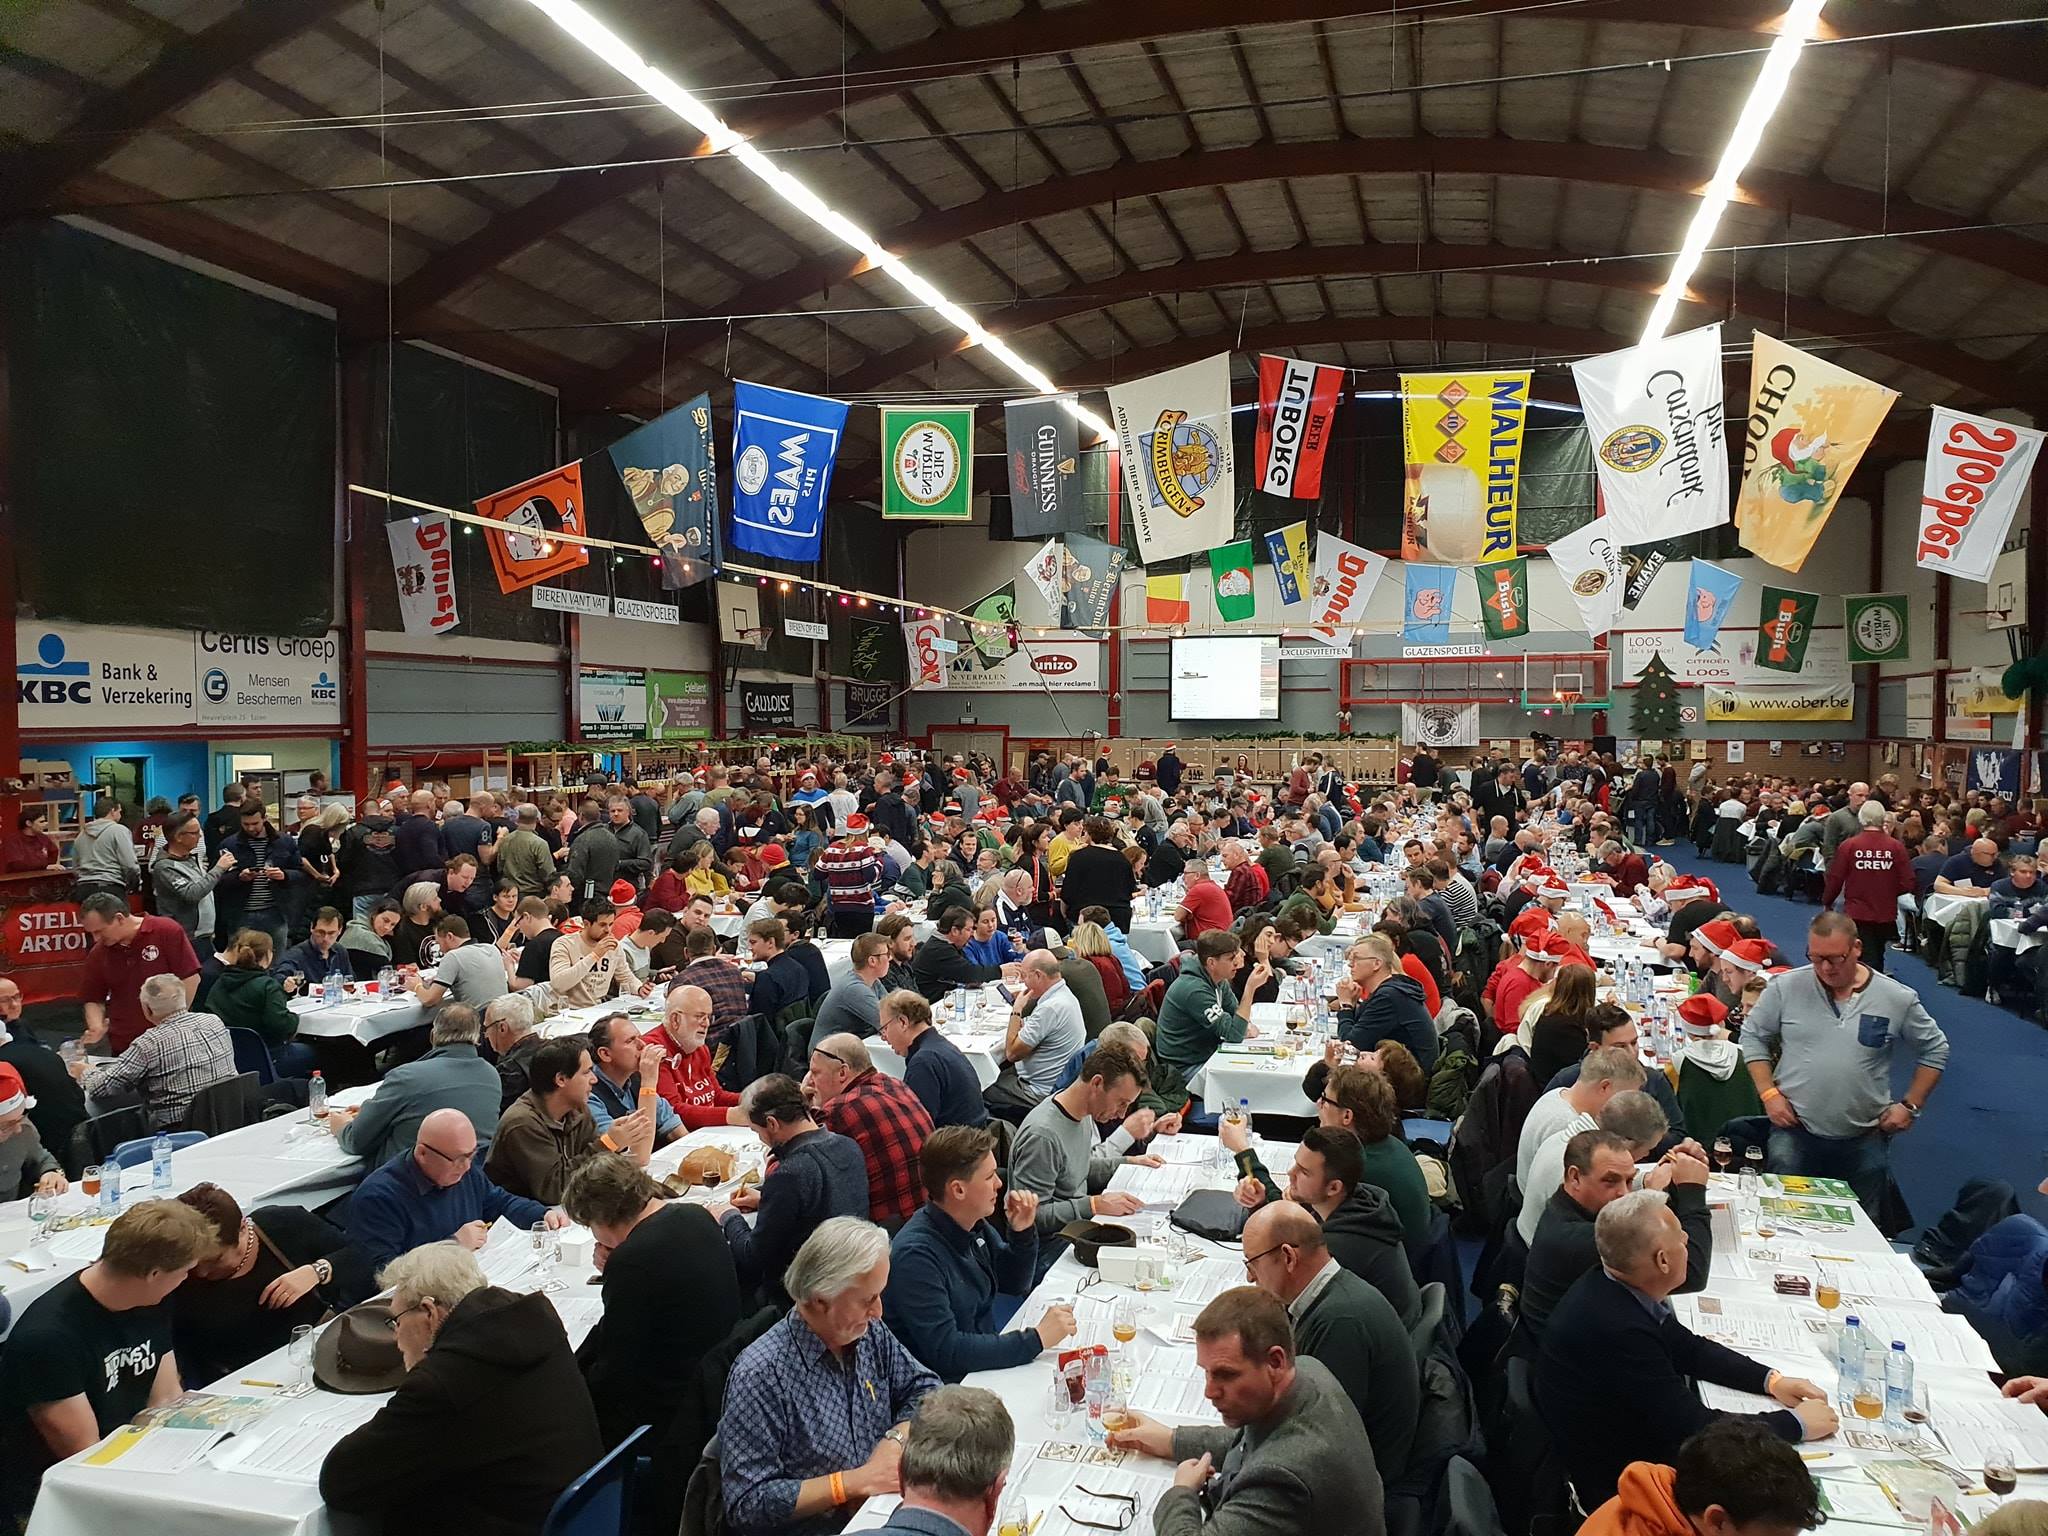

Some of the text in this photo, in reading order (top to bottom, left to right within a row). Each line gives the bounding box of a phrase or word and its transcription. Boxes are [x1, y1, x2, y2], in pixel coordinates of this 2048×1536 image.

[1447, 415, 1459, 429] 10
[1031, 452, 1039, 490] DRAUGHT
[1038, 424, 1058, 514] GUINNESS
[1483, 379, 1525, 557] MALHEUR
[537, 588, 568, 605] BIEREN
[591, 597, 606, 609] VAT
[1498, 580, 1513, 619] Bush
[616, 601, 678, 622] GLAZENSPOELER
[1773, 610, 1792, 649] Bush
[201, 631, 336, 664] Certis Groep
[1628, 636, 1662, 647] LOOS
[1280, 647, 1349, 656] EXCLUSIVITEITEN
[1404, 645, 1481, 656] GLAZENSPOELER
[1646, 647, 1674, 655] sevice!
[102, 663, 158, 681] Bank &
[1035, 656, 1074, 671] unizo
[249, 673, 290, 688] Mensen
[1686, 668, 1730, 677] LOOS
[1048, 679, 1062, 687] hier
[17, 680, 92, 704] KBC
[102, 687, 192, 709] Verzekering
[237, 691, 302, 705] Beschermen
[311, 689, 336, 699] KBC
[850, 685, 888, 702] BRUGGE
[745, 691, 790, 713] GAULOISE
[1749, 696, 1849, 710] www.ober.be
[1855, 860, 1893, 870] CREW
[18, 911, 85, 931] STELL
[19, 932, 87, 954] ARTOI
